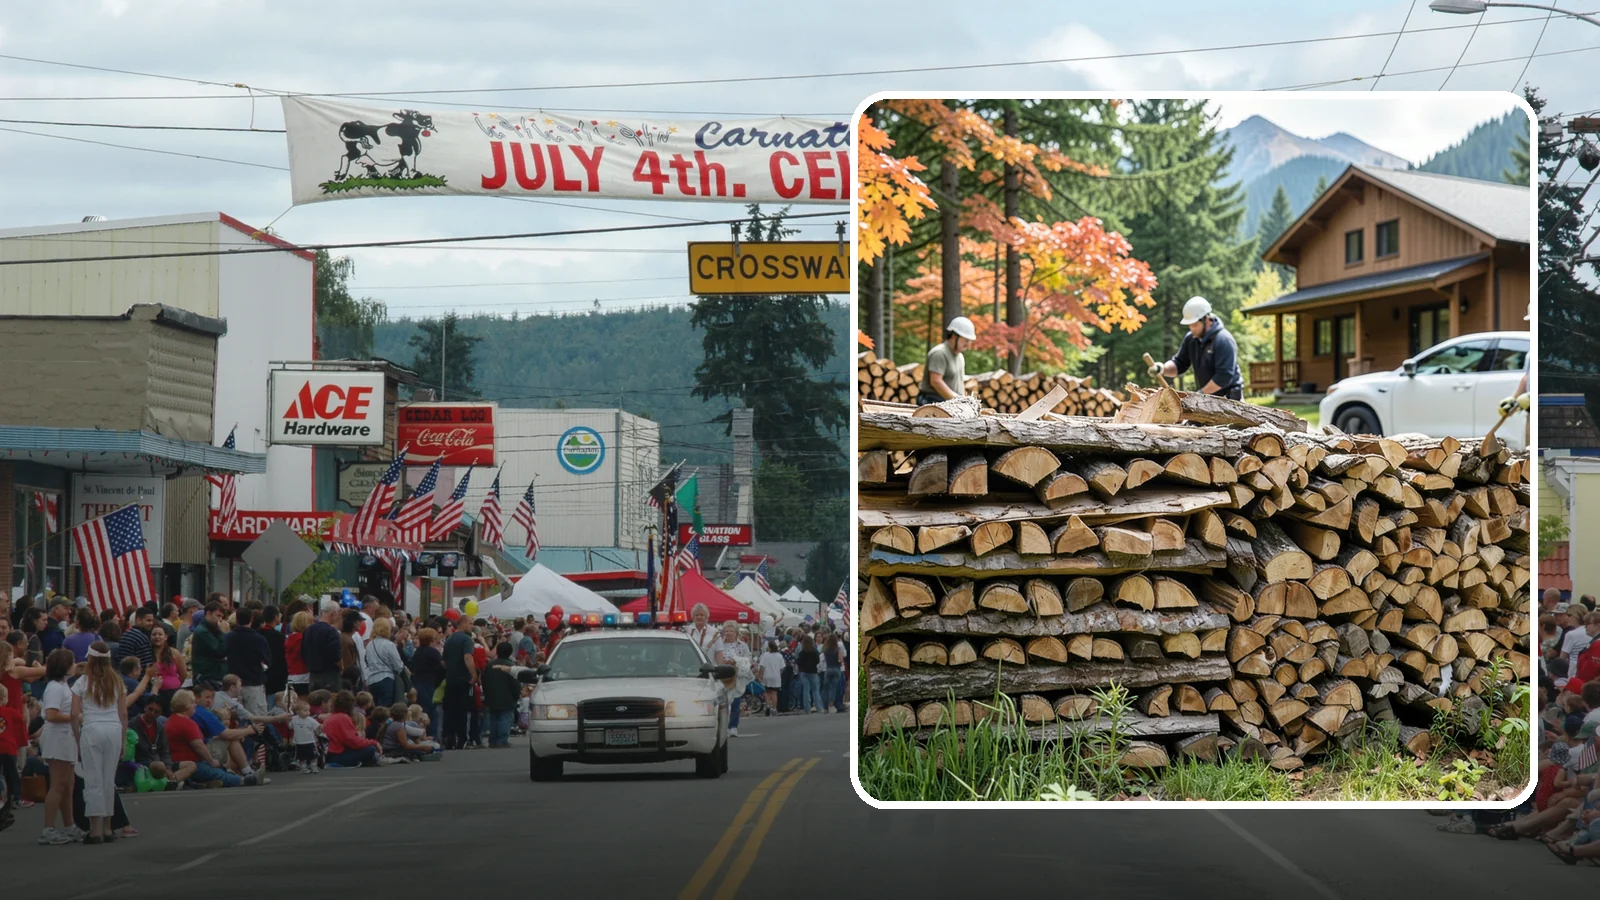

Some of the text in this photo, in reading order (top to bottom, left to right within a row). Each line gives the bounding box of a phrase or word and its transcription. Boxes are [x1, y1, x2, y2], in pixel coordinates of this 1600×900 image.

[481, 141, 605, 192] JULY
[633, 150, 746, 198] 4th.
[696, 254, 850, 280] CROSSWA
[283, 380, 373, 420] ACE
[406, 409, 485, 422] CEDAR LOG
[283, 421, 370, 436] Hardware
[416, 428, 477, 447] Coca-Cola
[83, 485, 155, 495] St. Vincent de Paul
[688, 526, 741, 535] CRNATION
[699, 535, 730, 543] GLASS
